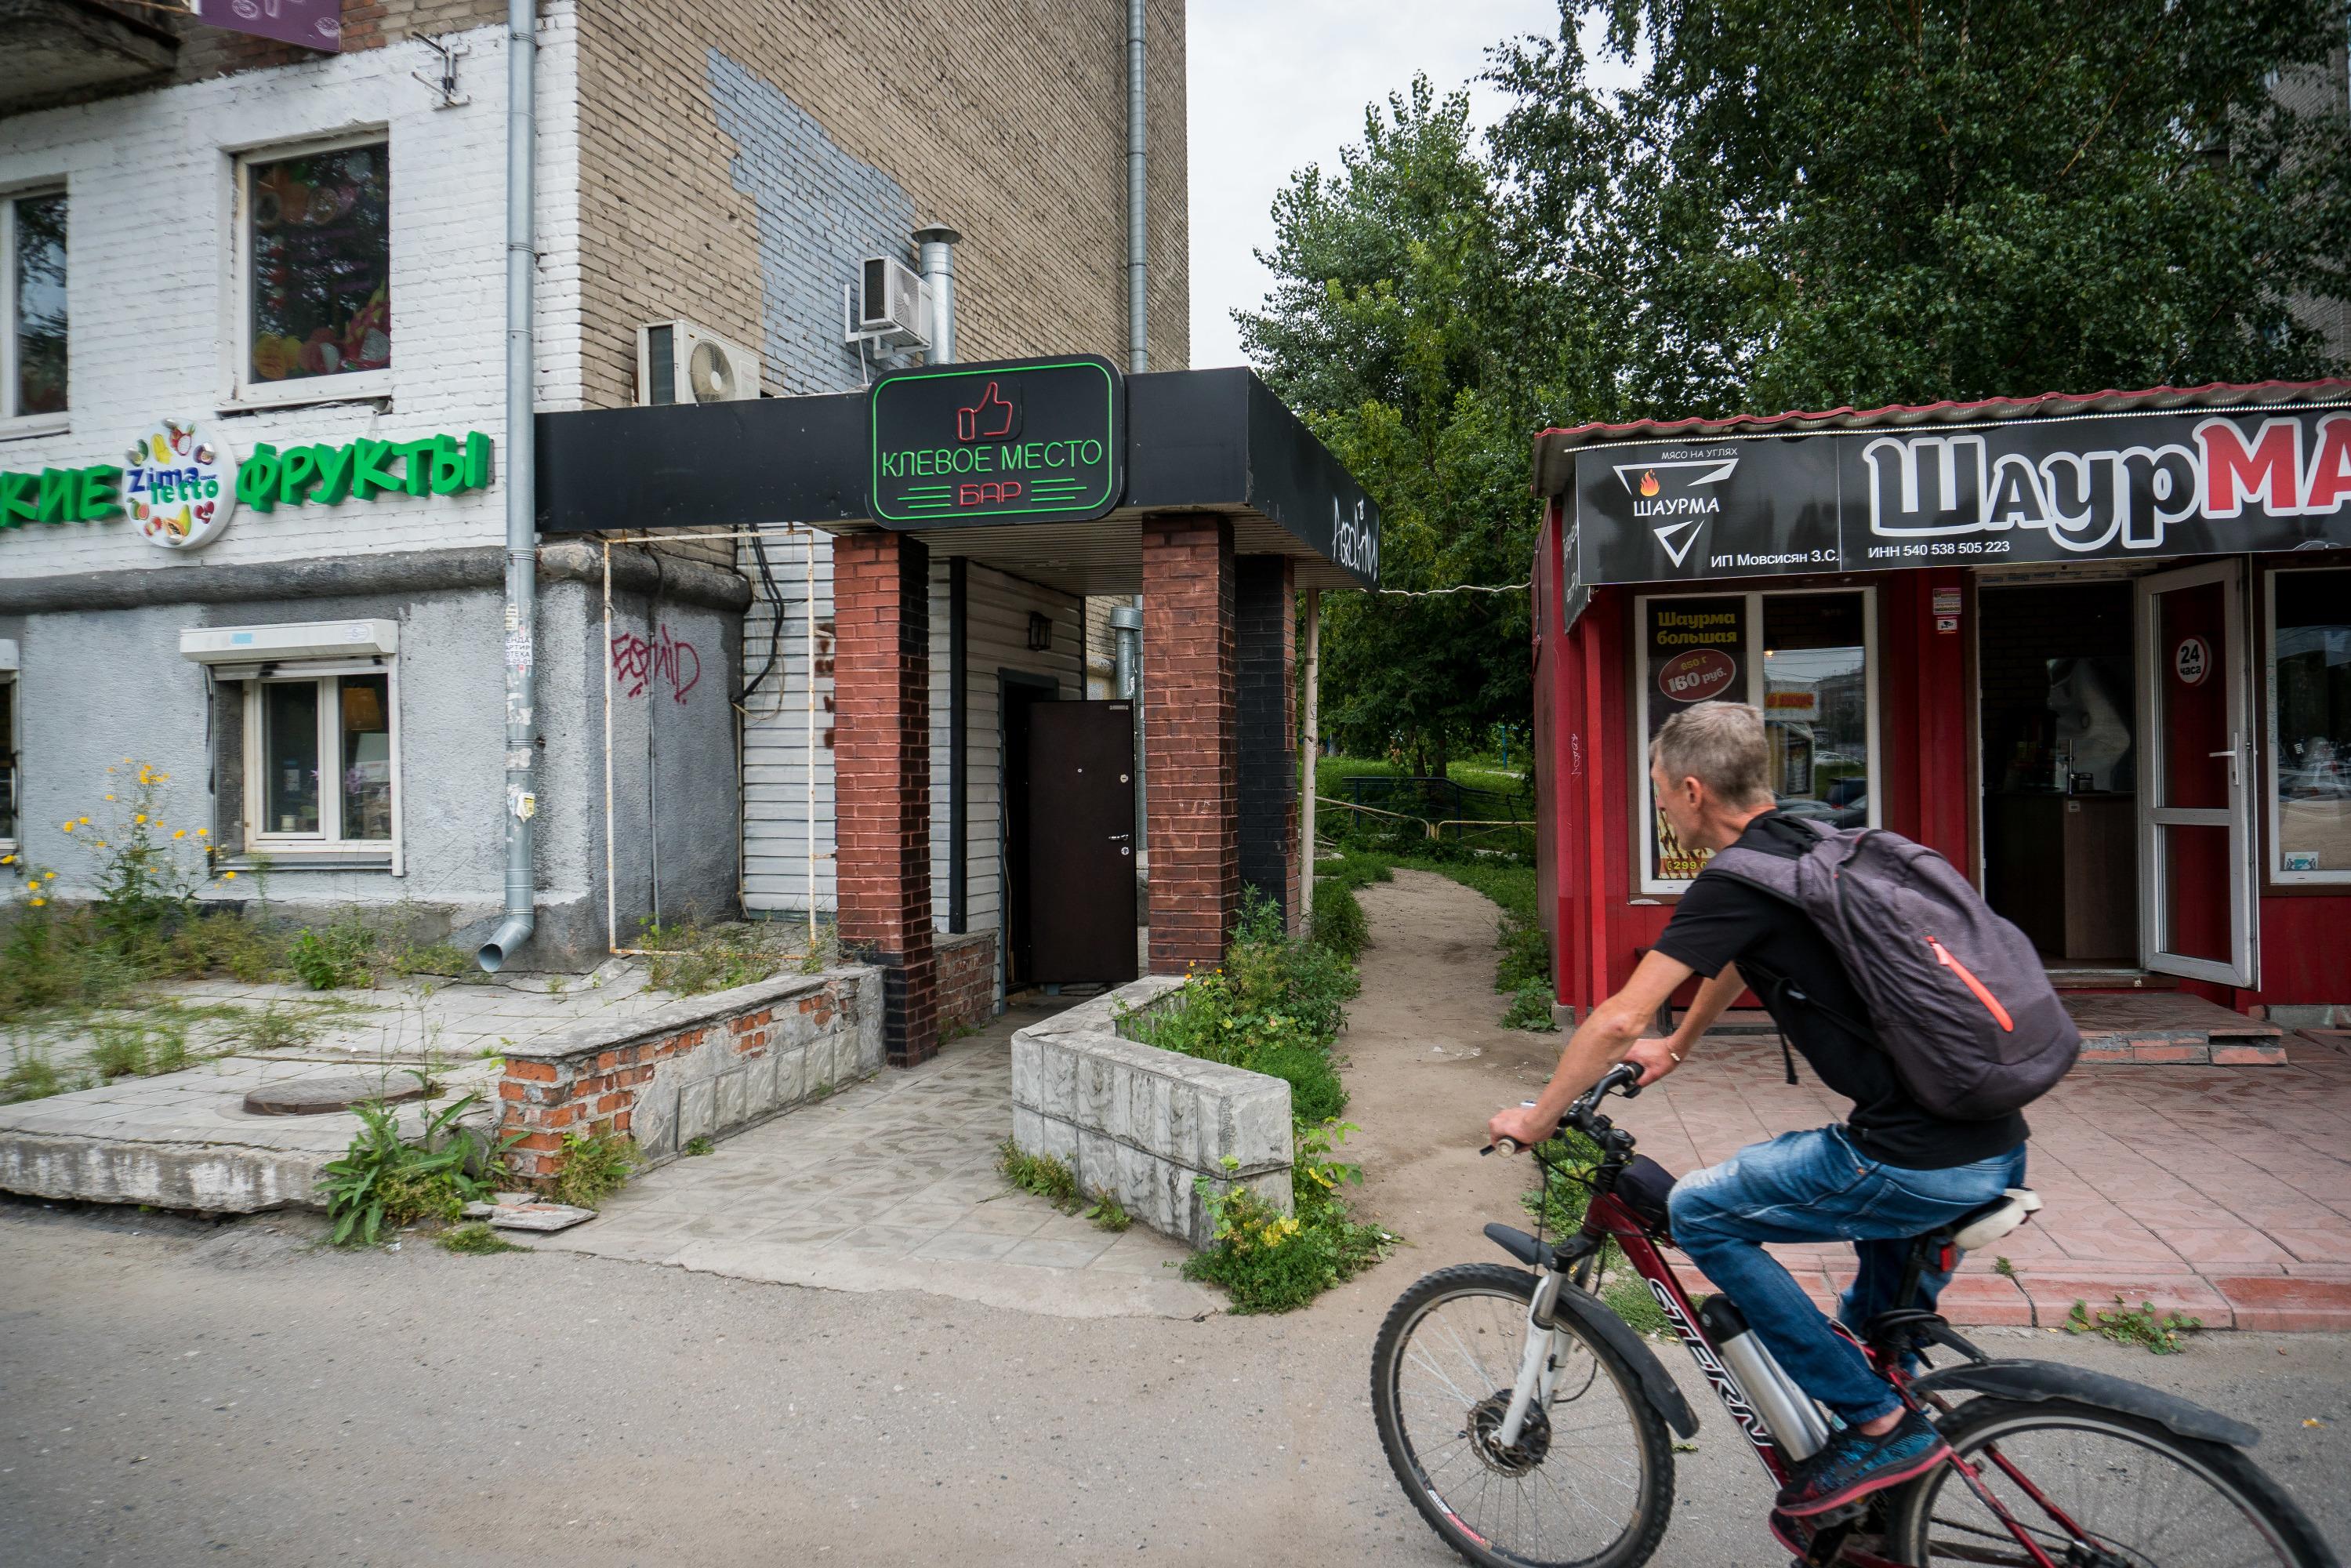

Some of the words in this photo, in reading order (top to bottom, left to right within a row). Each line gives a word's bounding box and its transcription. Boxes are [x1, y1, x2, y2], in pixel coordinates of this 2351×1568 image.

[882, 445, 992, 477] КЛЕВОЕ
[1000, 439, 1102, 470] МЕСТО
[1661, 451, 1688, 459] МЯСО
[1690, 450, 1704, 459] НА
[1707, 448, 1738, 457] УГЛЯХ
[127, 466, 199, 492] Zima
[236, 430, 490, 514] ФРУКТЫ
[959, 481, 1021, 506] БАР
[1633, 497, 1720, 517] ШАУРМА
[1868, 546, 1900, 558] ИНН
[1903, 544, 1928, 557] 540
[1930, 543, 1955, 555] 538
[1957, 542, 1983, 554] 505
[1984, 541, 2010, 553] 223
[1711, 554, 1733, 568] ИП
[1736, 553, 1808, 566] Мовсисян
[1657, 612, 1736, 628] Шаурма
[1656, 630, 1738, 644] большая
[2180, 644, 2200, 664] 24
[1702, 667, 1727, 684] руб.
[2179, 666, 2201, 676] часа
[1649, 1278, 1774, 1446] STERN
